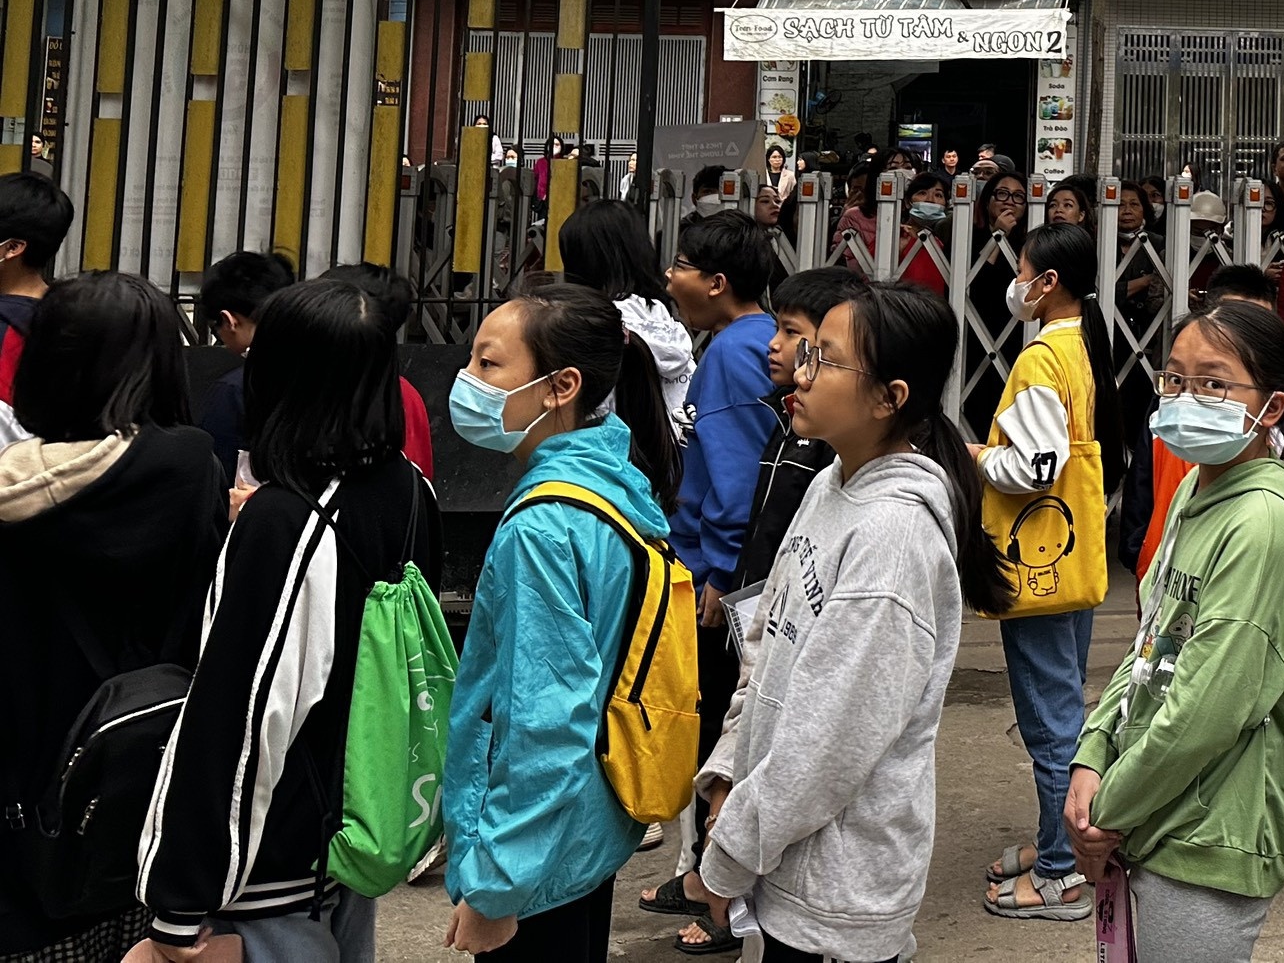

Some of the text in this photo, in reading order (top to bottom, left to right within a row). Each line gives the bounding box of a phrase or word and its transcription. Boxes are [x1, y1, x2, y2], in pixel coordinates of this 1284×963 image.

[783, 14, 1062, 54] SẠCH TỪ TÂM & NGON 2
[1031, 451, 1058, 486] 17
